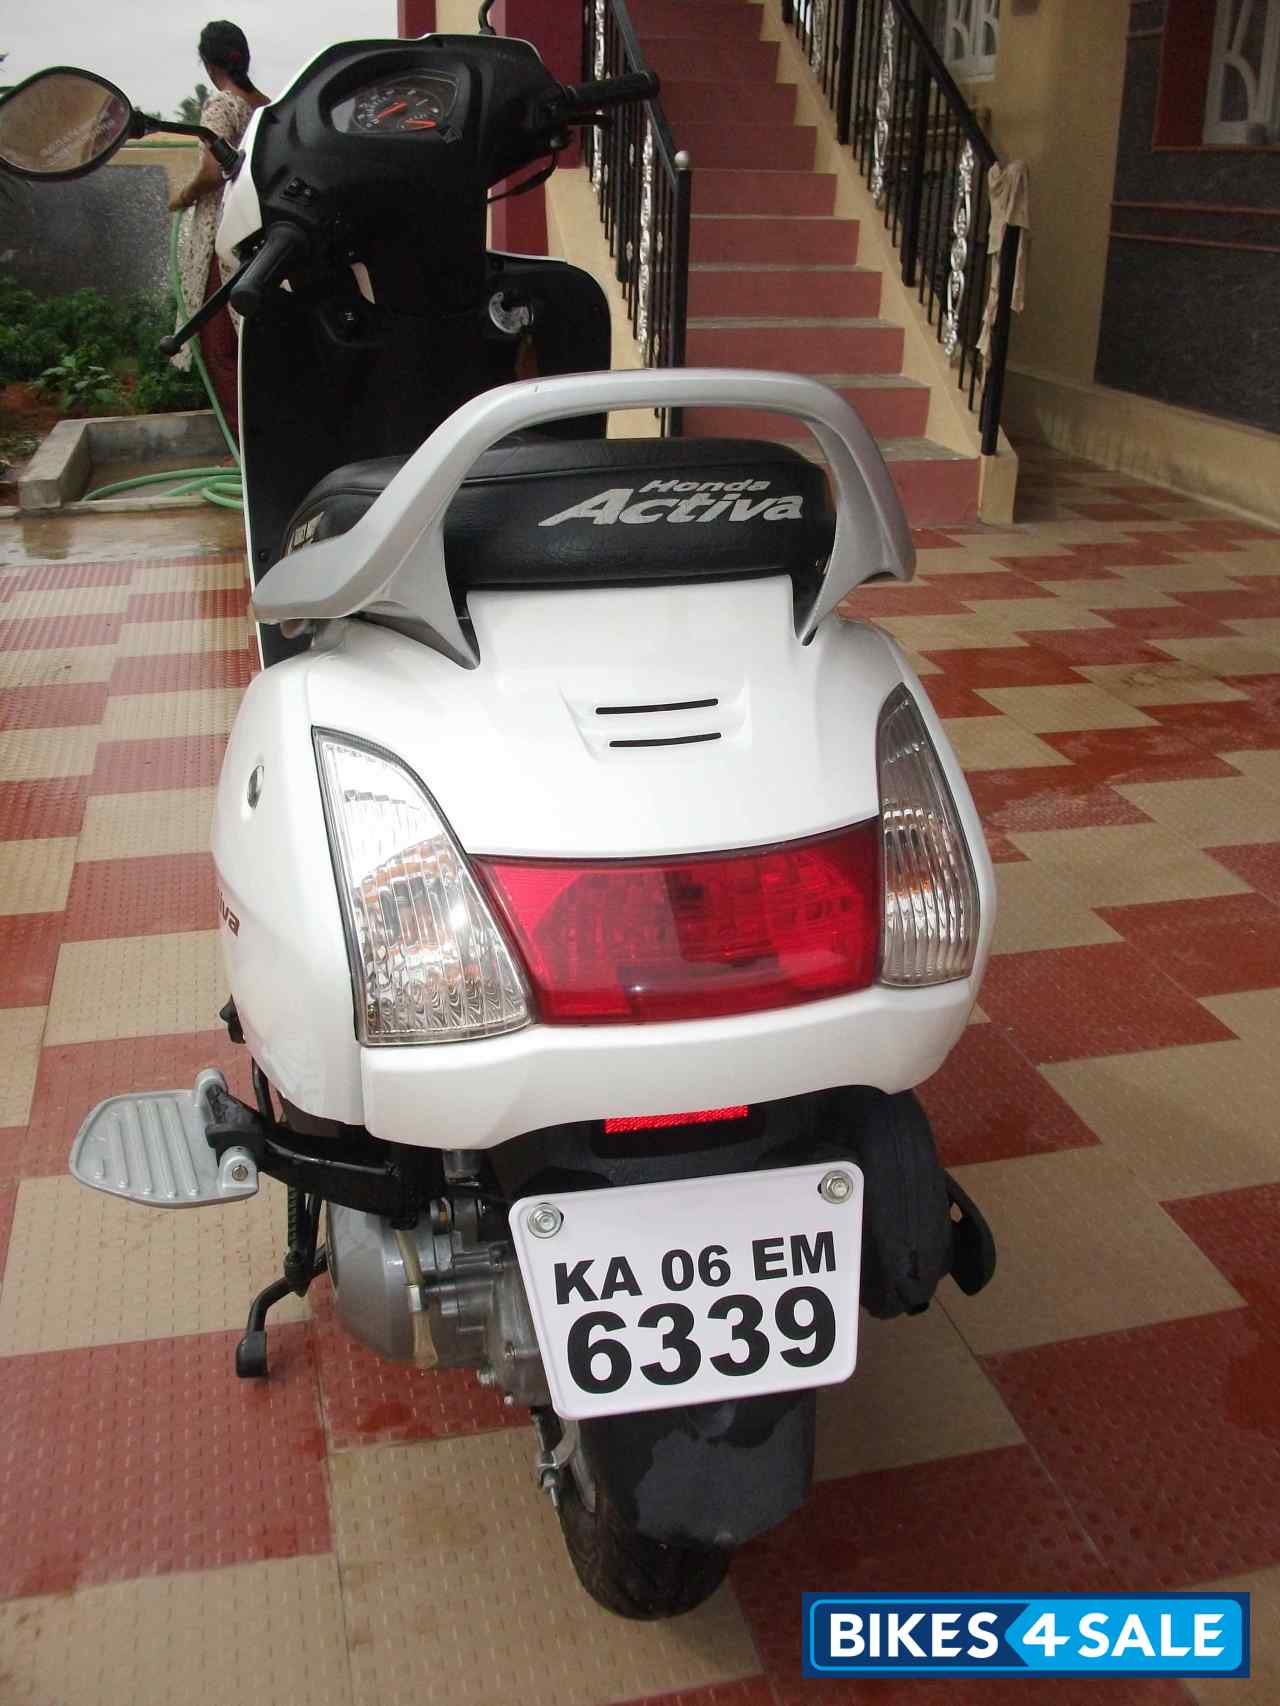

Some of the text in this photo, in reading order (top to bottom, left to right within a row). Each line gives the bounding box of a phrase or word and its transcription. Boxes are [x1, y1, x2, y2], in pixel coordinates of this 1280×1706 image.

[538, 488, 803, 527] Activa
[638, 479, 771, 493] Honda
[553, 1230, 837, 1305] KA 06 EM
[566, 1285, 837, 1395] 6339
